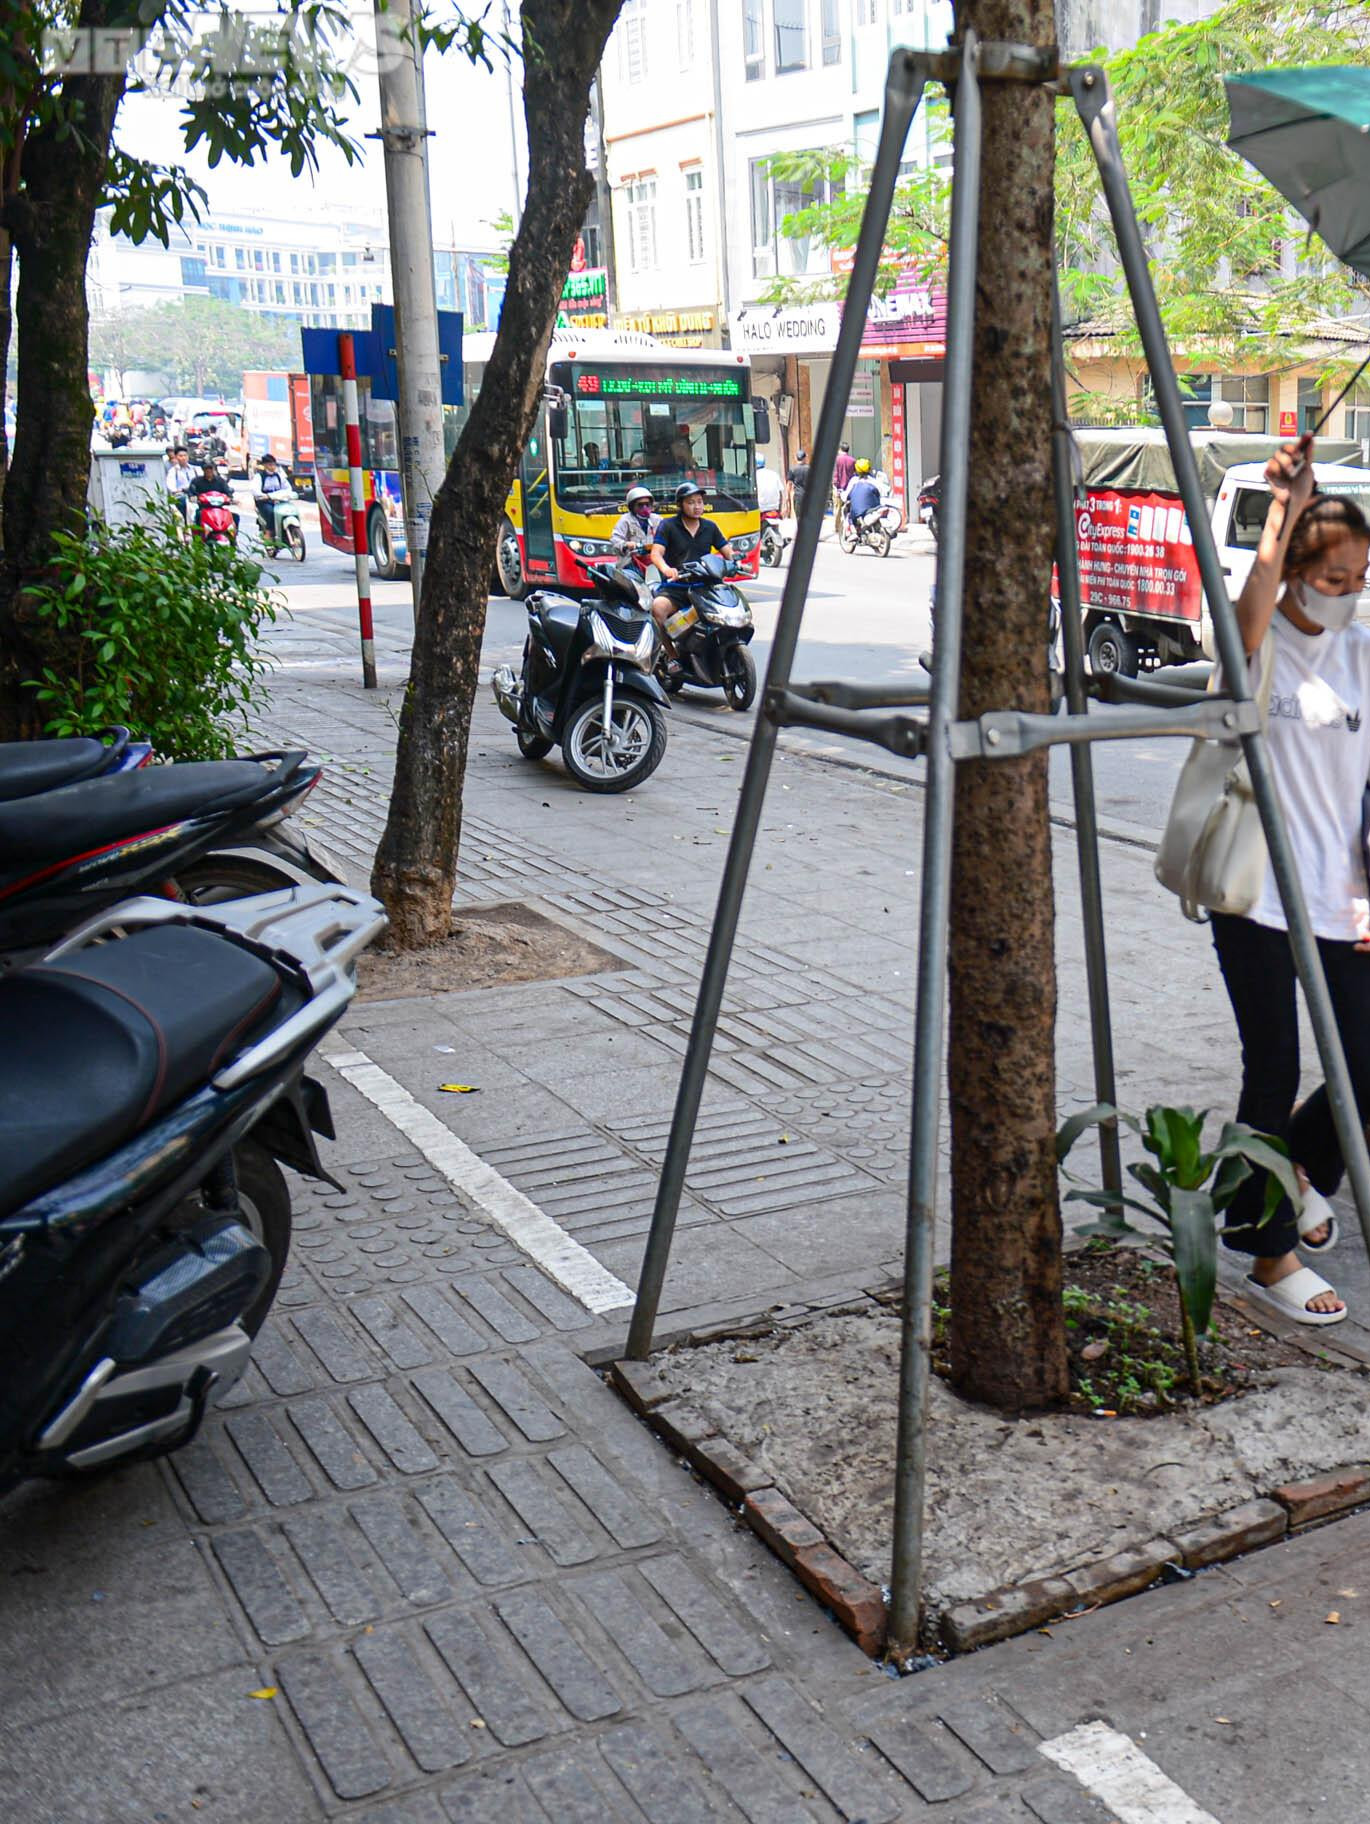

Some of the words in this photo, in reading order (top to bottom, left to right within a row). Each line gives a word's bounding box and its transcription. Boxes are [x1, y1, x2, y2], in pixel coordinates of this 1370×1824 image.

[743, 321, 771, 340] HALO
[776, 318, 825, 338] WEDDING
[1089, 497, 1096, 512] 3
